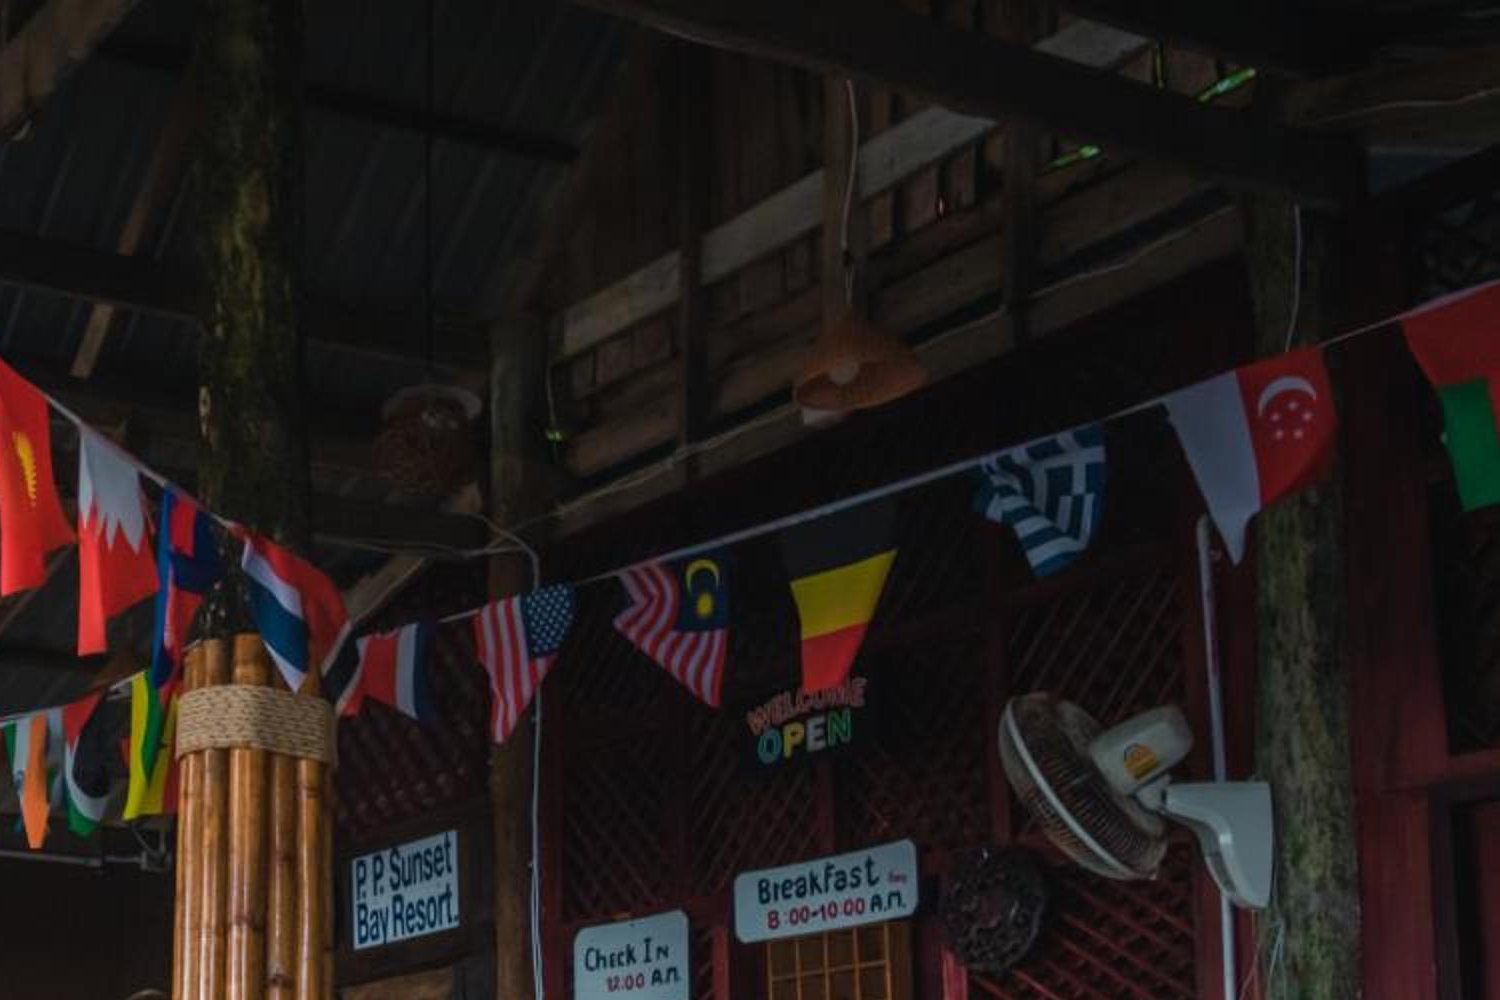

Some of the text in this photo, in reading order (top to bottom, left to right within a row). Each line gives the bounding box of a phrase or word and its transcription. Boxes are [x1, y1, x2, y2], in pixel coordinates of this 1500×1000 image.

[757, 707, 851, 764] OPEN
[389, 832, 452, 891] Sunset
[757, 856, 880, 904] Breakfast
[357, 903, 388, 944] Bay
[607, 973, 645, 992] 12:00
